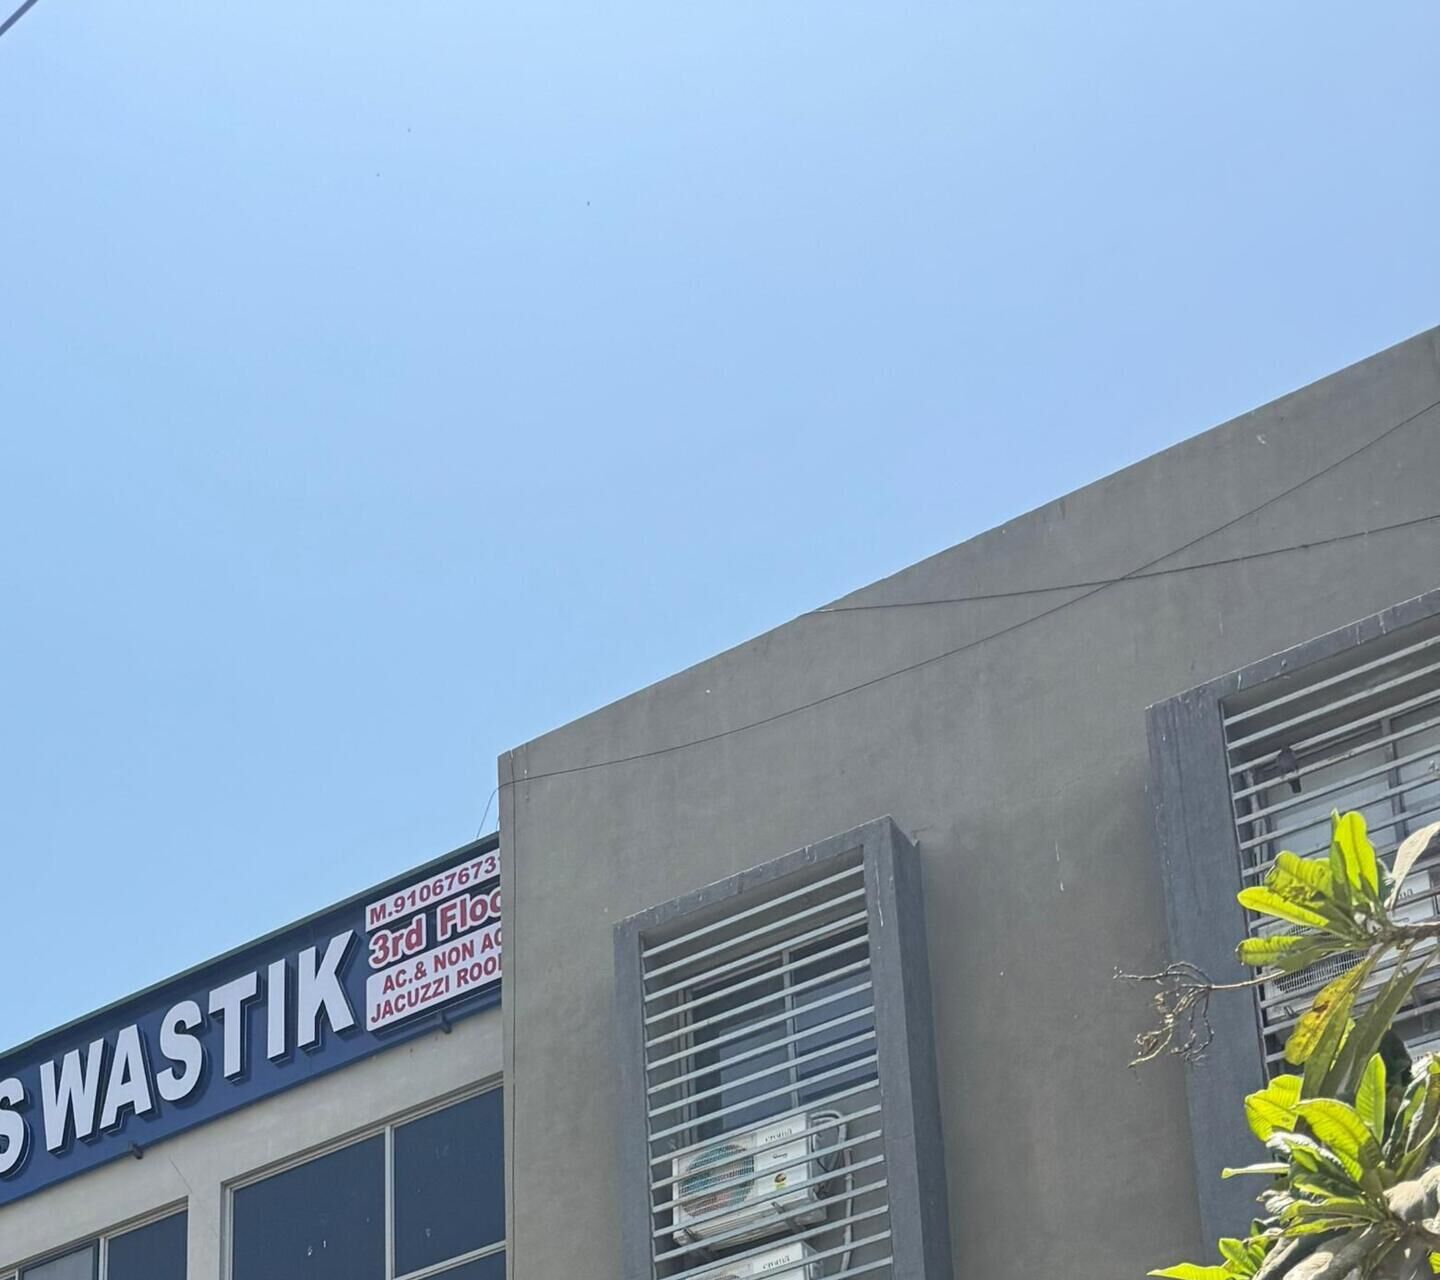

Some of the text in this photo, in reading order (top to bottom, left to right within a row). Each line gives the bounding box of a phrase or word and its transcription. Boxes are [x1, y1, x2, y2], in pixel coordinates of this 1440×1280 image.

[369, 855, 500, 925] M.91067673
[371, 917, 424, 966] 3rd
[434, 940, 474, 973] NON
[371, 953, 502, 1023] JACUZZI ROO
